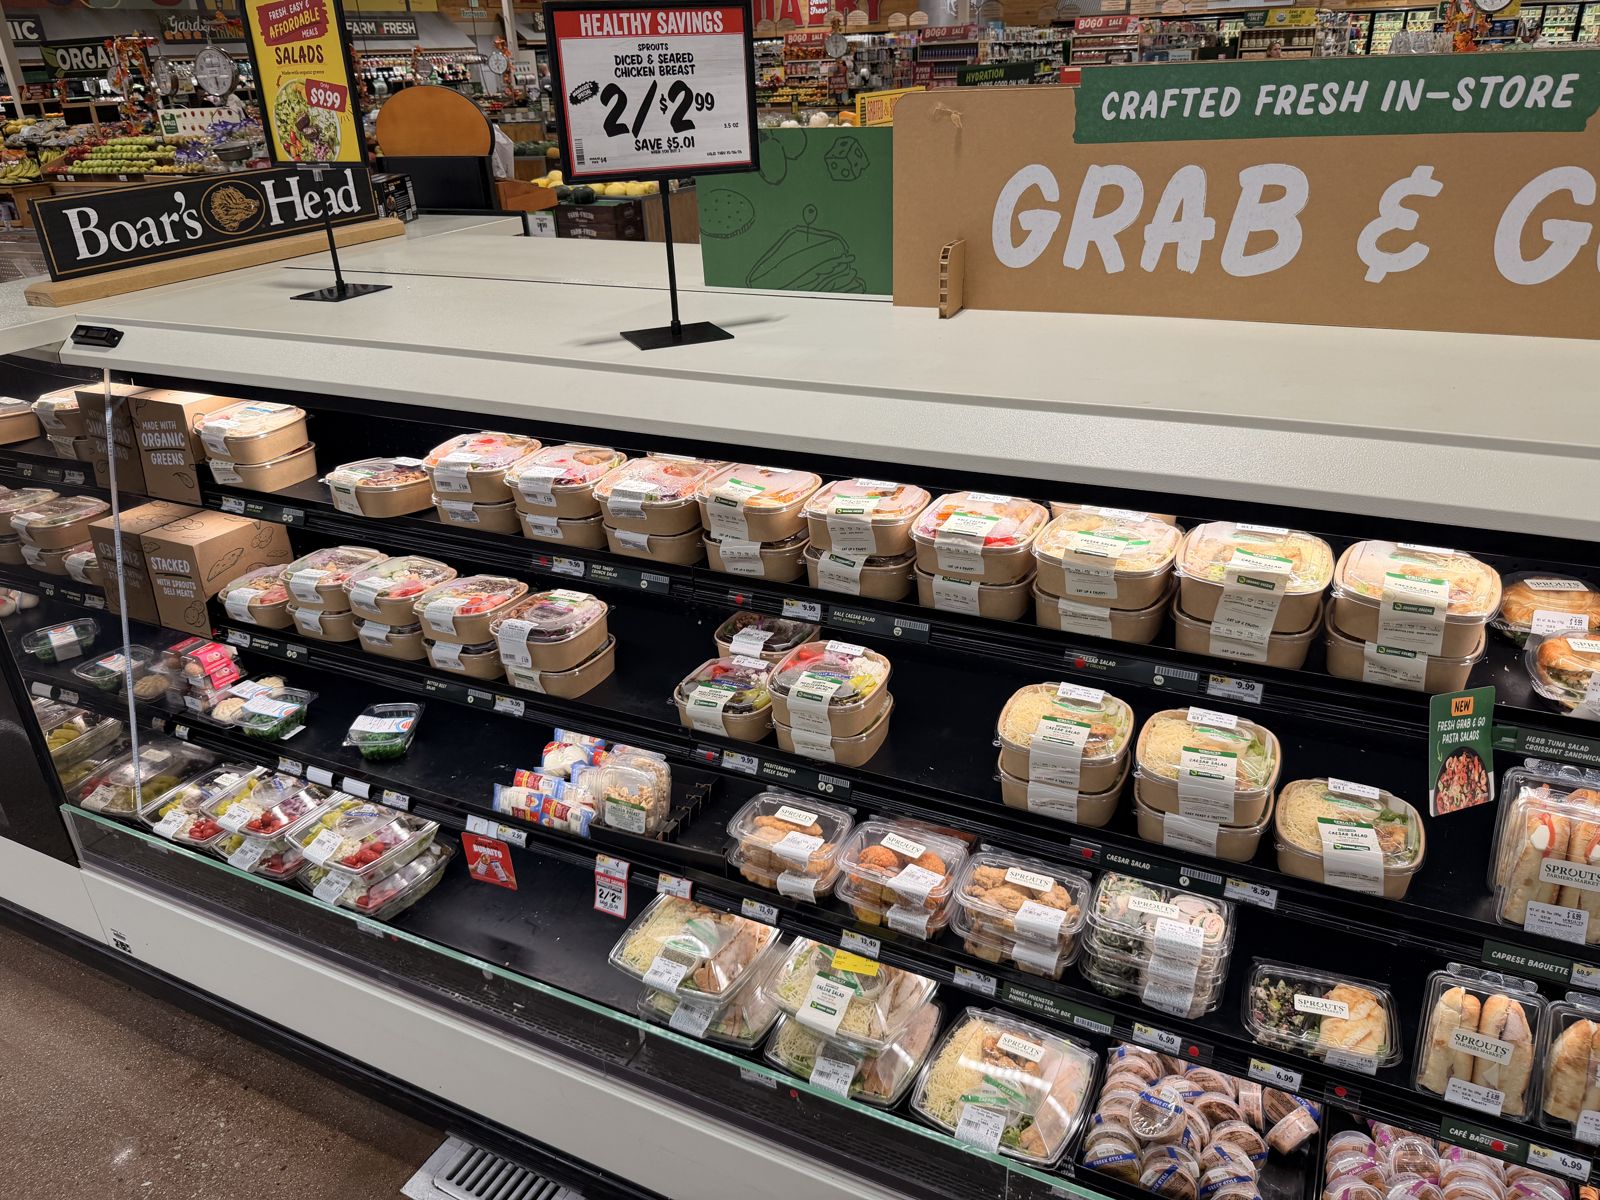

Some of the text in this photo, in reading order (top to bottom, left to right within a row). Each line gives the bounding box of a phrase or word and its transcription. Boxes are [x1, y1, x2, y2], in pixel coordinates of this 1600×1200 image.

[269, 7, 321, 39] AFFORDABLE
[382, 21, 416, 35] FRESH
[580, 12, 651, 37] HEALTHY
[656, 10, 724, 35] SAVINGS
[1078, 17, 1123, 30] BOGO SALE
[301, 26, 319, 38] MEALS
[788, 33, 823, 43] BOGO SALE
[925, 27, 964, 38] BOGO SALE
[637, 42, 669, 51] SPROUTS
[274, 44, 324, 66] SALADS
[614, 52, 694, 66] DICED & SEARED
[614, 64, 696, 78] CHICKEN BREAST
[965, 68, 1005, 83] HYDRATION
[310, 87, 341, 109] $9.99
[1101, 73, 1580, 122] CRAFTED FRESH IN-STORE
[634, 135, 695, 151] SAVE $5.01
[62, 168, 362, 261] Boar's Head
[992, 163, 1600, 286] GRAB & G
[142, 420, 177, 431] MADE WITH
[141, 432, 186, 448] ORGANIC
[150, 452, 185, 466] GREENS
[150, 555, 191, 574] STACKED
[156, 578, 197, 591] WITH SPROUTS
[163, 586, 195, 598] DELI MEATS
[861, 614, 876, 623] SALAD
[1099, 658, 1116, 667] SALAD
[1235, 681, 1256, 692] $9.99
[1454, 700, 1471, 713] NEW
[1437, 719, 1455, 732] FRESH
[1456, 718, 1471, 730] GRAB
[1477, 716, 1486, 727] GO
[1442, 730, 1480, 744] PASTA SALADS
[1526, 735, 1590, 752] HERB TUNA SALAD
[1525, 743, 1563, 756] CROISSANT
[780, 808, 816, 823] SPROUTS
[886, 834, 921, 854] SPROUTS
[1106, 853, 1151, 871] CAESAR SALAD
[1009, 869, 1049, 887] SPROUTS
[1544, 863, 1600, 883] SPROUTS
[1546, 872, 1573, 884] FARMERS
[1131, 898, 1178, 915] SPROUTS
[1491, 950, 1570, 976] CAPRESE BAGUETTE
[1009, 987, 1054, 1006] TURKEY MUENSTER
[1008, 993, 1071, 1018] PINWHEEL DUO SNACK BOX
[1297, 998, 1346, 1012] SPROUTS
[1001, 1036, 1041, 1056] SPROUTS
[1156, 1033, 1175, 1045] $6.99
[1453, 1033, 1508, 1056] SPROUTS
[1455, 1041, 1503, 1059] FARMERS MARKET
[1275, 1070, 1294, 1084] $6.99
[1449, 1126, 1509, 1151] CAFÉ BAGUE
[1559, 1156, 1582, 1171] $6.99
[1222, 1177, 1238, 1187] STYLE
